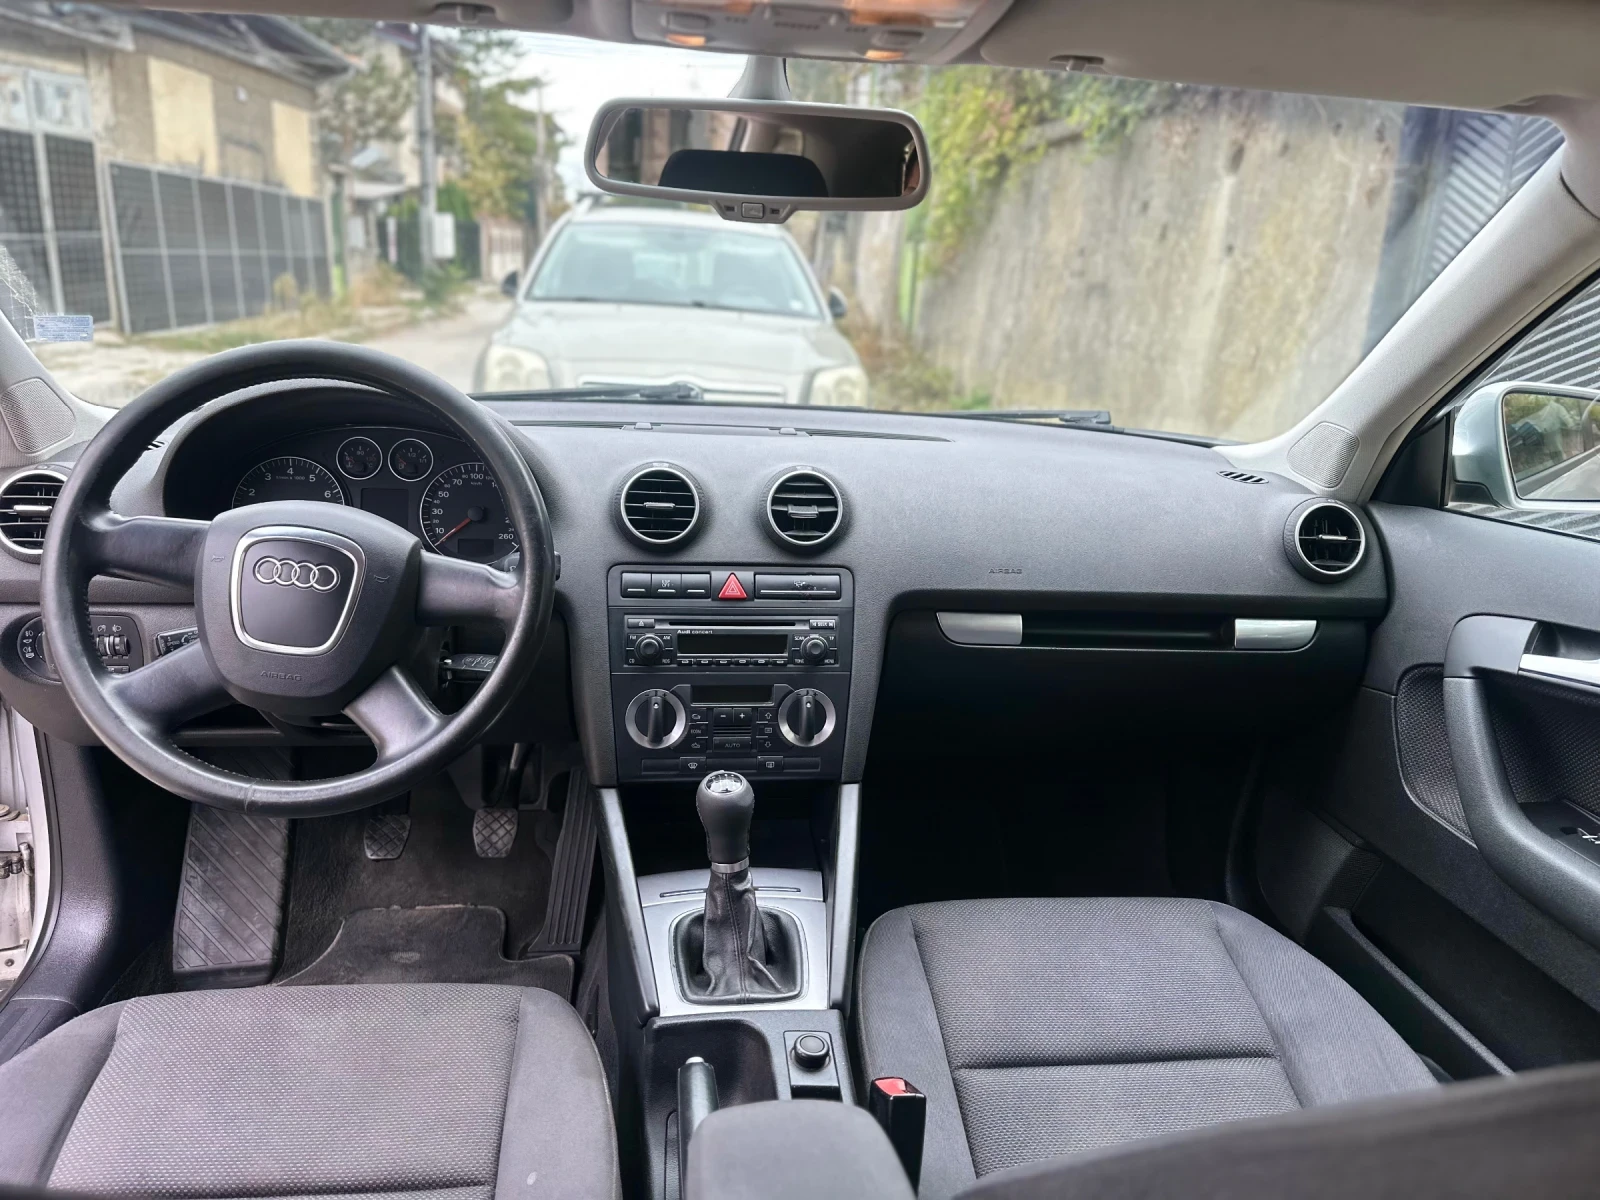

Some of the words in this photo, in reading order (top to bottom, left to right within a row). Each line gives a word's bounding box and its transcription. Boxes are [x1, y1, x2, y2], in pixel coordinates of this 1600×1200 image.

[264, 472, 272, 480] 3
[324, 490, 332, 498] 6
[260, 670, 302, 681] AIRBAG
